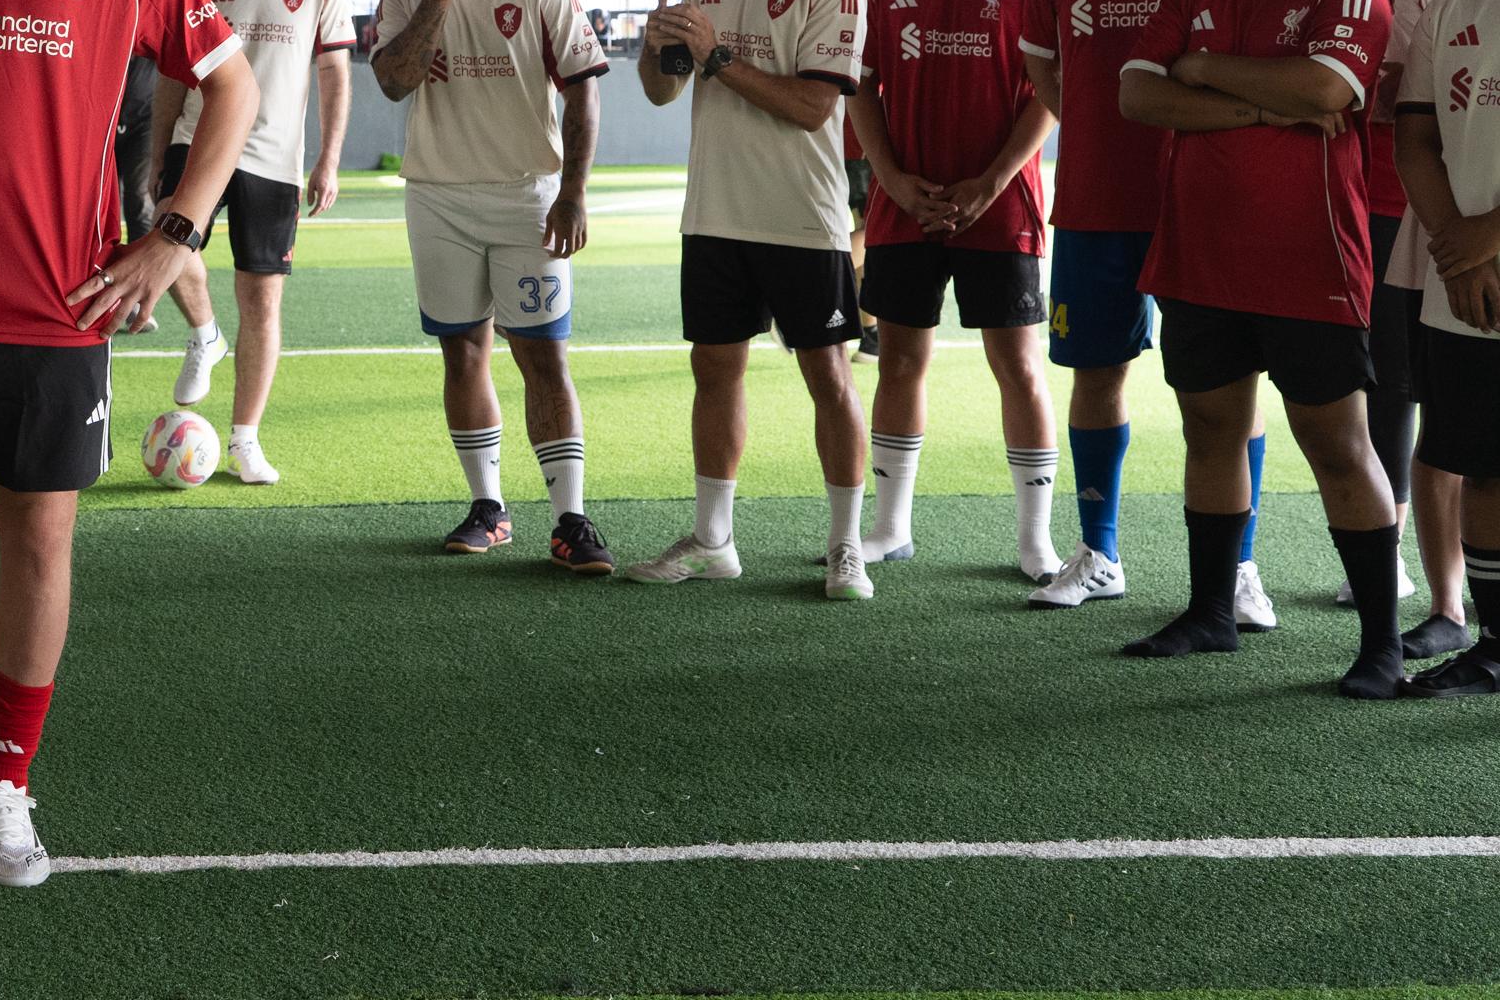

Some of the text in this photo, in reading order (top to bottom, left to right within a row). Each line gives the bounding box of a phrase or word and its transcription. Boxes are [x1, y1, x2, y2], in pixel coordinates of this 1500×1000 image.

[1100, 0, 1158, 14] standa
[1308, 40, 1369, 64] Expedia
[518, 276, 561, 312] 37
